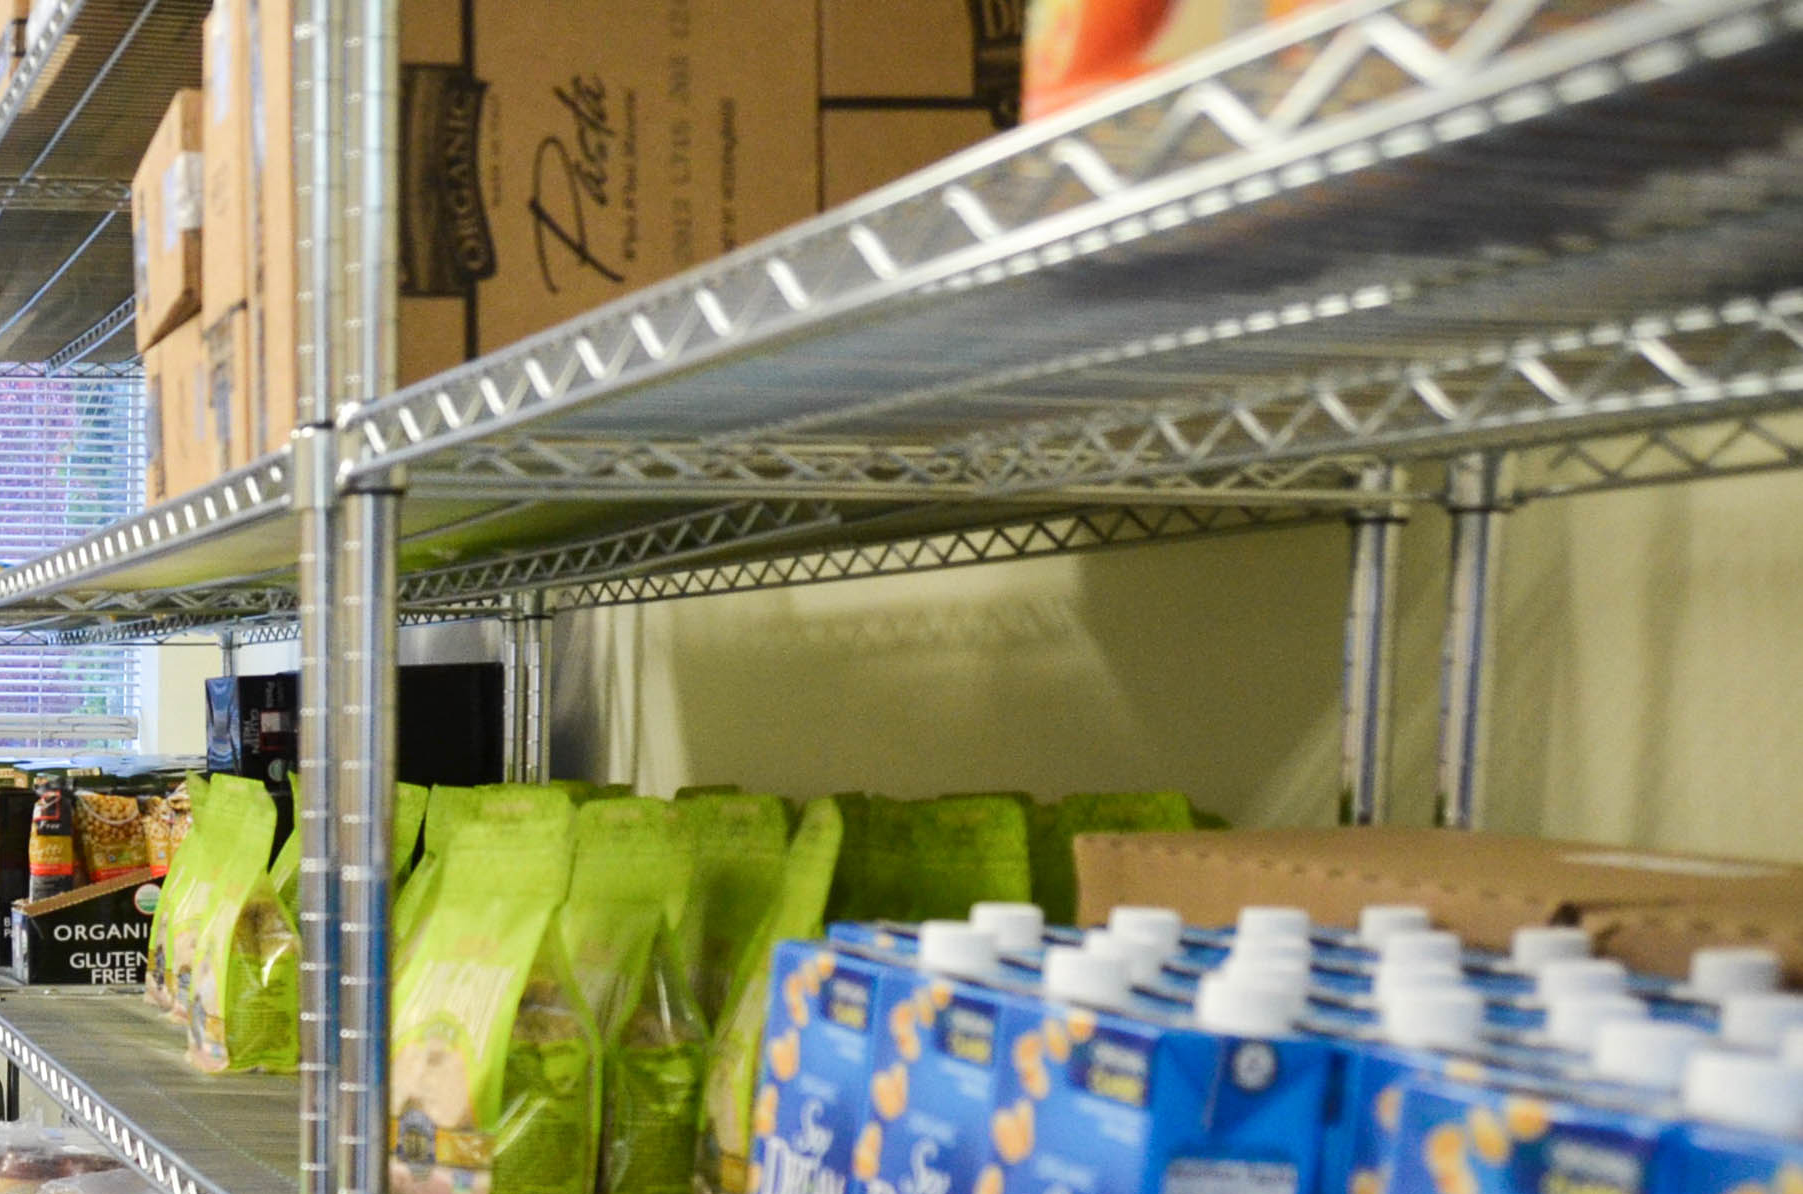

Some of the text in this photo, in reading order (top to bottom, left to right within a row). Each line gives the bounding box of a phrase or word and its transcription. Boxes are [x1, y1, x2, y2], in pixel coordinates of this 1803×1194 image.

[53, 922, 148, 942] ORGANI
[69, 951, 149, 969] GLUTEN
[91, 967, 138, 985] FREE
